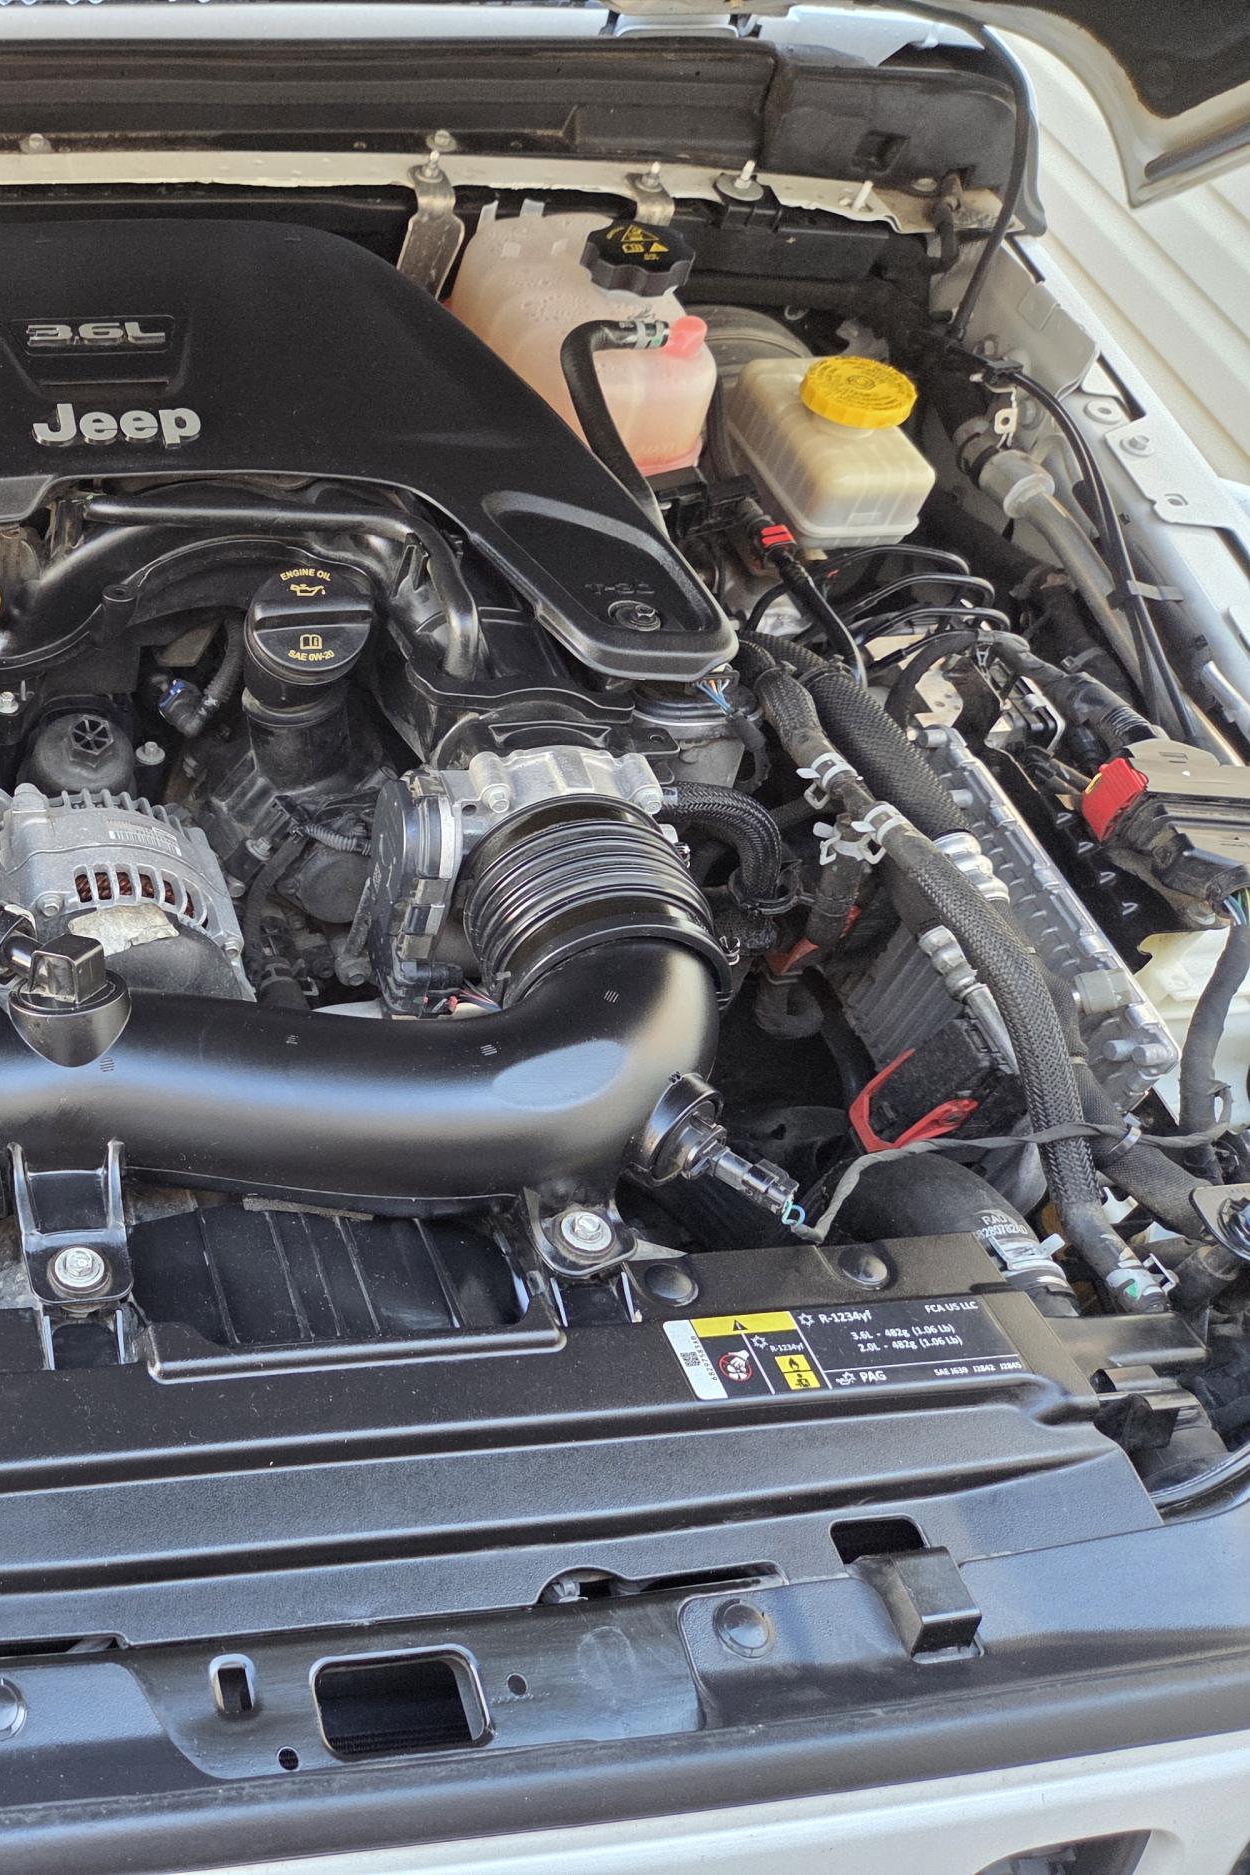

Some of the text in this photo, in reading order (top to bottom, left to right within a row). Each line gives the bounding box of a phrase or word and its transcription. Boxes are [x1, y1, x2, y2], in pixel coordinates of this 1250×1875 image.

[26, 322, 166, 347] 3.6L
[31, 403, 201, 449] Jeep
[280, 568, 331, 581] ENGINE OIL
[288, 649, 335, 661] SAE 0W-20
[924, 1301, 979, 1314] FCA US LLC
[818, 1310, 872, 1324] R-1234yf
[850, 1330, 874, 1340] 3.6L
[884, 1328, 911, 1339] 482g
[912, 1325, 937, 1336] (1.06
[938, 1324, 956, 1334] Lb)
[770, 1342, 805, 1352] R-1234yf
[857, 1342, 881, 1352] 2.0L
[891, 1340, 918, 1351] 482g
[919, 1337, 945, 1348] (1.06
[945, 1335, 963, 1346] Lb)
[859, 1371, 887, 1383] PAG
[933, 1367, 950, 1376] SAE
